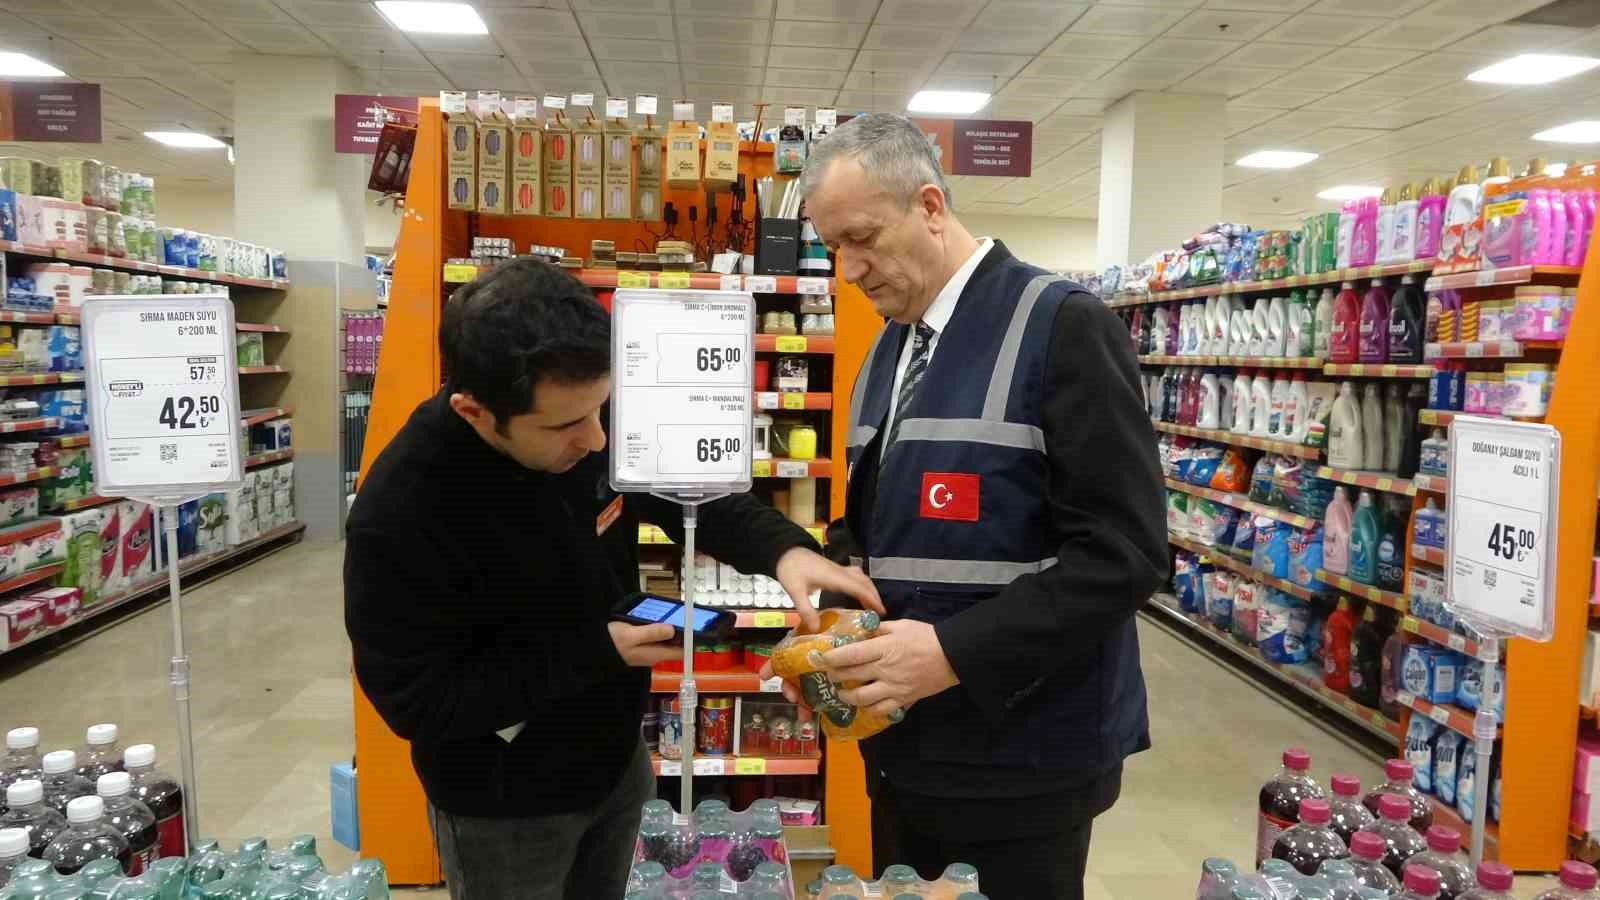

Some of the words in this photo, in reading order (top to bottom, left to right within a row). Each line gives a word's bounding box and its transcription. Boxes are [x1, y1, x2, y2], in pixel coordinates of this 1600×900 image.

[167, 312, 194, 321] MADEN
[197, 311, 216, 320] SUYU
[206, 325, 218, 335] ML
[697, 347, 741, 372] 65,00
[159, 395, 219, 429] 42,50
[697, 438, 741, 462] 65,00
[1472, 441, 1499, 456] DOĞANAY
[1499, 443, 1524, 460] ŞALGAM
[1524, 448, 1541, 462] SUYU
[1488, 522, 1535, 560] 45,00
